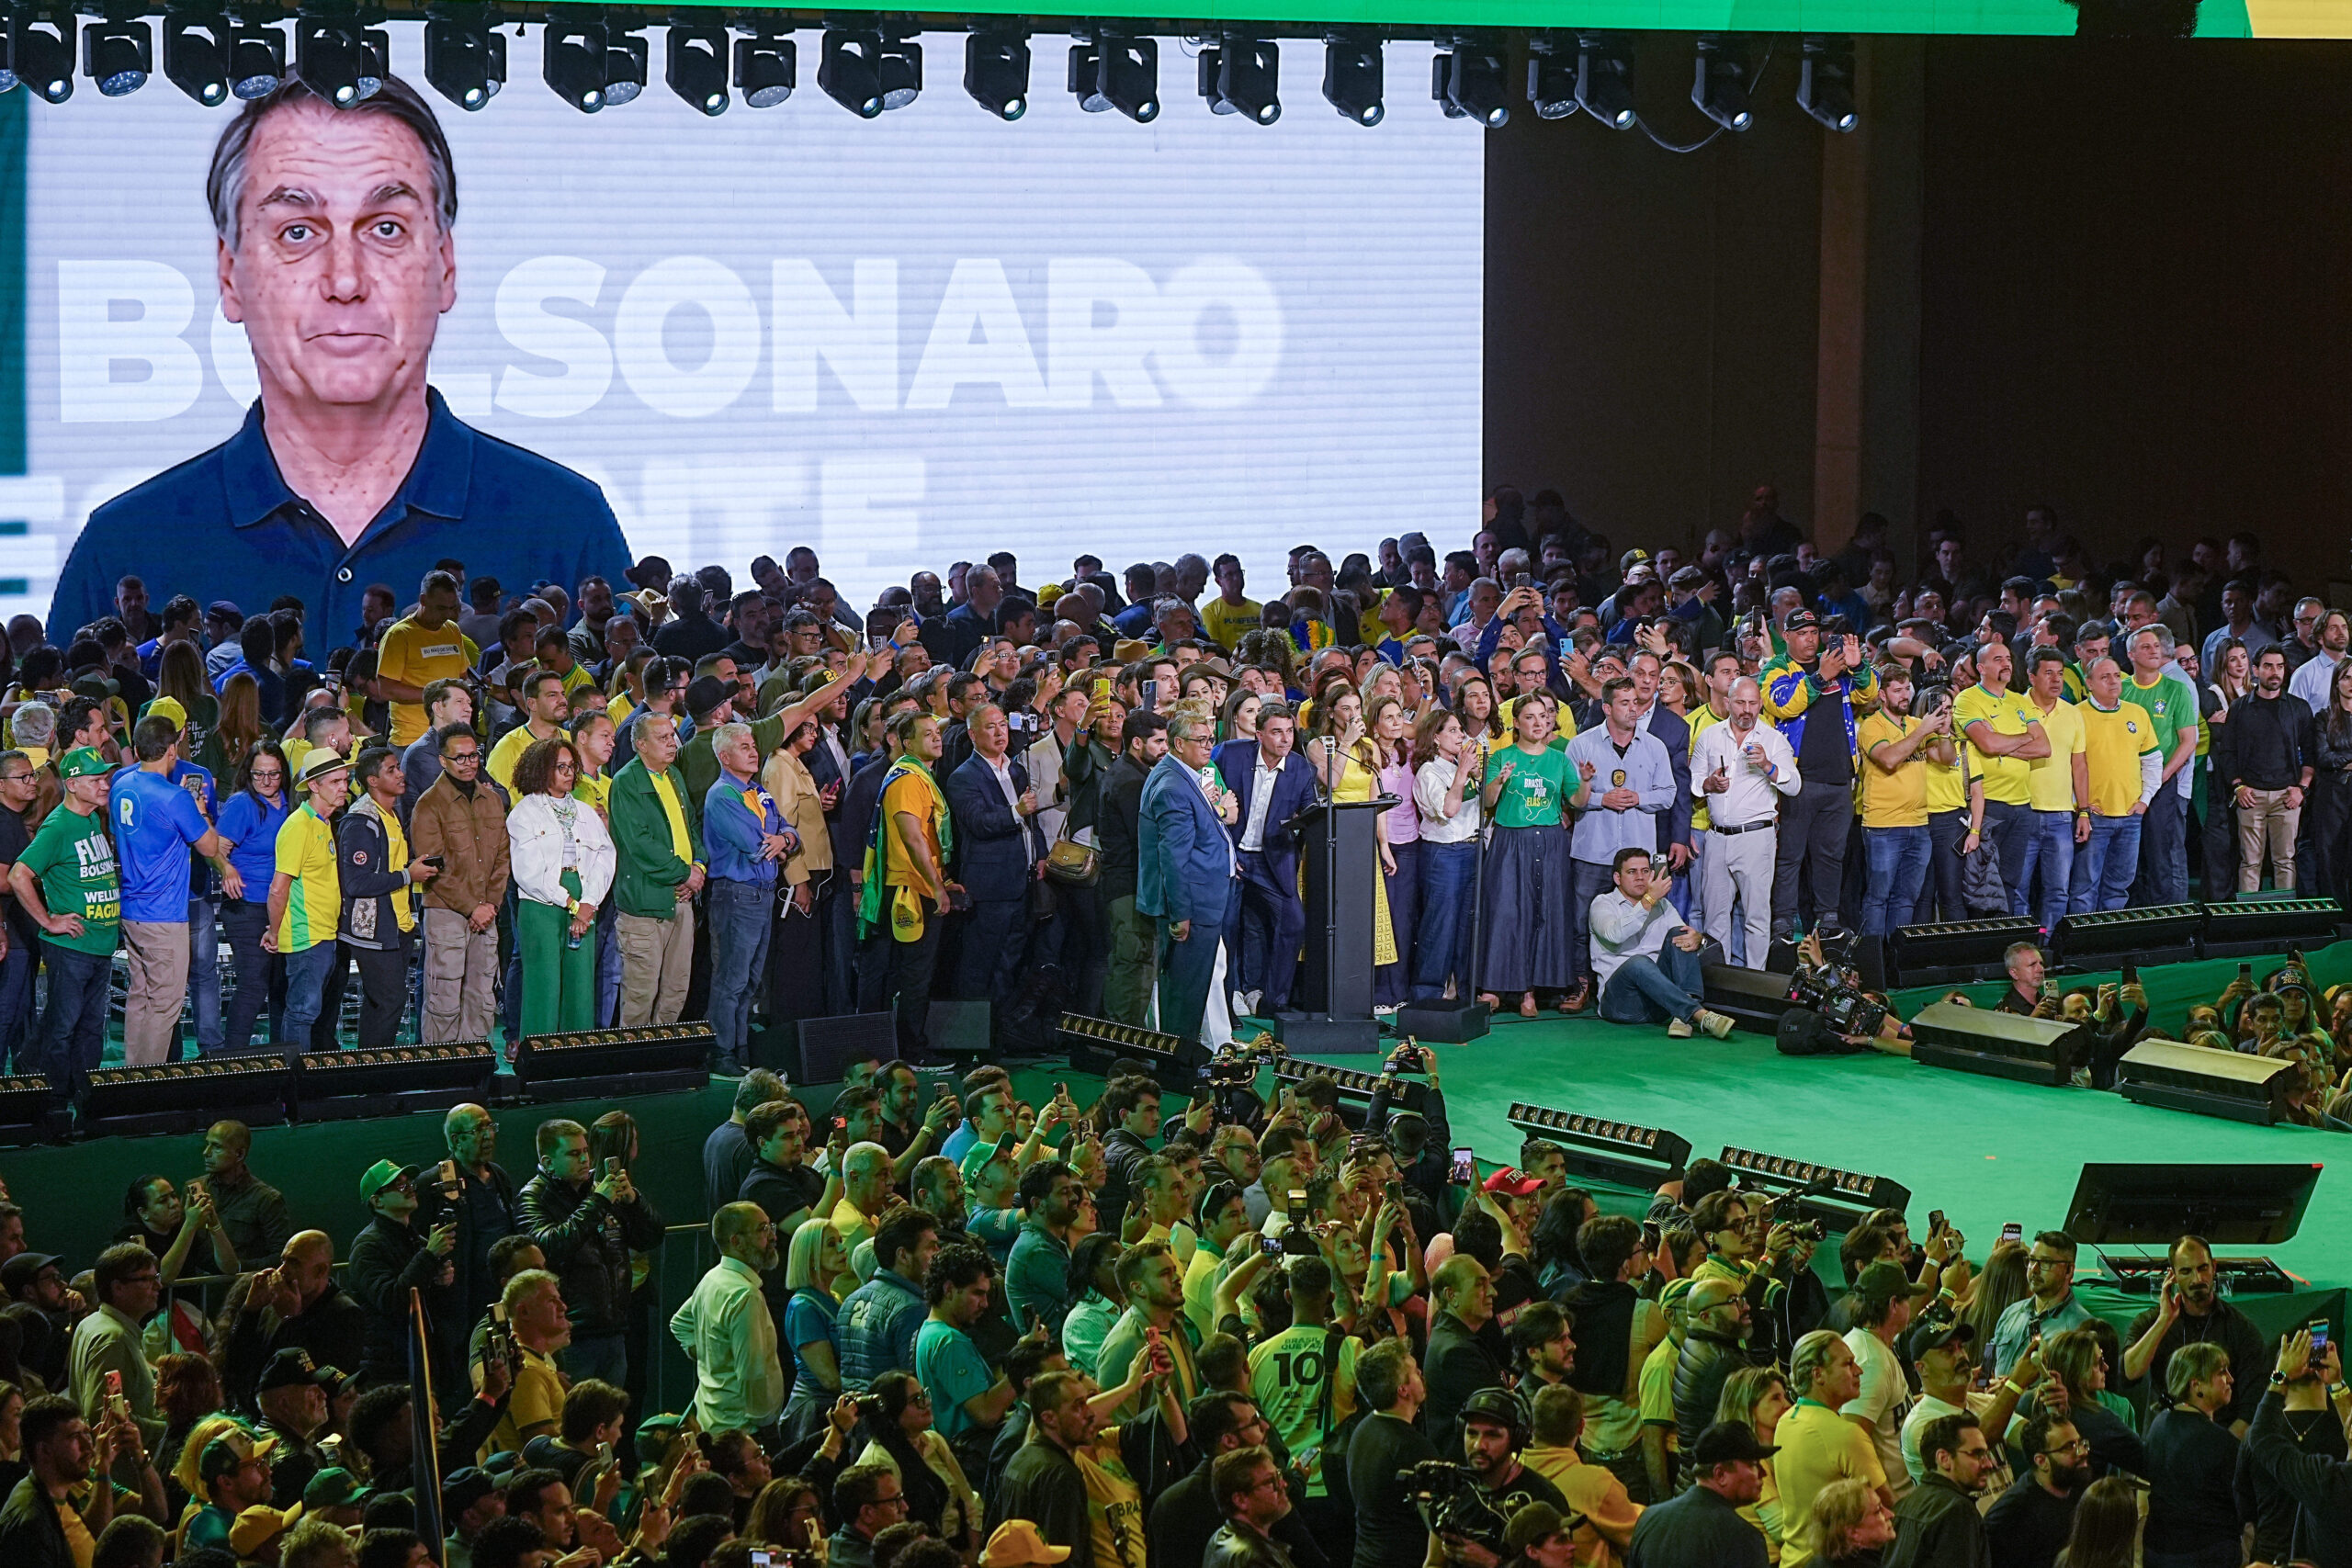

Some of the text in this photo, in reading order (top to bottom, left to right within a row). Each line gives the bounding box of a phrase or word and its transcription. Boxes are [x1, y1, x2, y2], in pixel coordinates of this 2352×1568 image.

[58, 254, 1283, 422] BSONARO
[69, 766, 81, 776] 22
[1524, 778, 1544, 788] BRASIL
[1533, 787, 1547, 797] POR
[1526, 796, 1541, 807] ELAS
[120, 797, 134, 827] R
[84, 887, 120, 903] WELLIN
[85, 901, 120, 919] FAGUN
[1505, 1168, 1525, 1184] TRU
[850, 1300, 872, 1327] 22
[1273, 1351, 1324, 1388] 10
[1117, 1500, 1142, 1517] BRA
